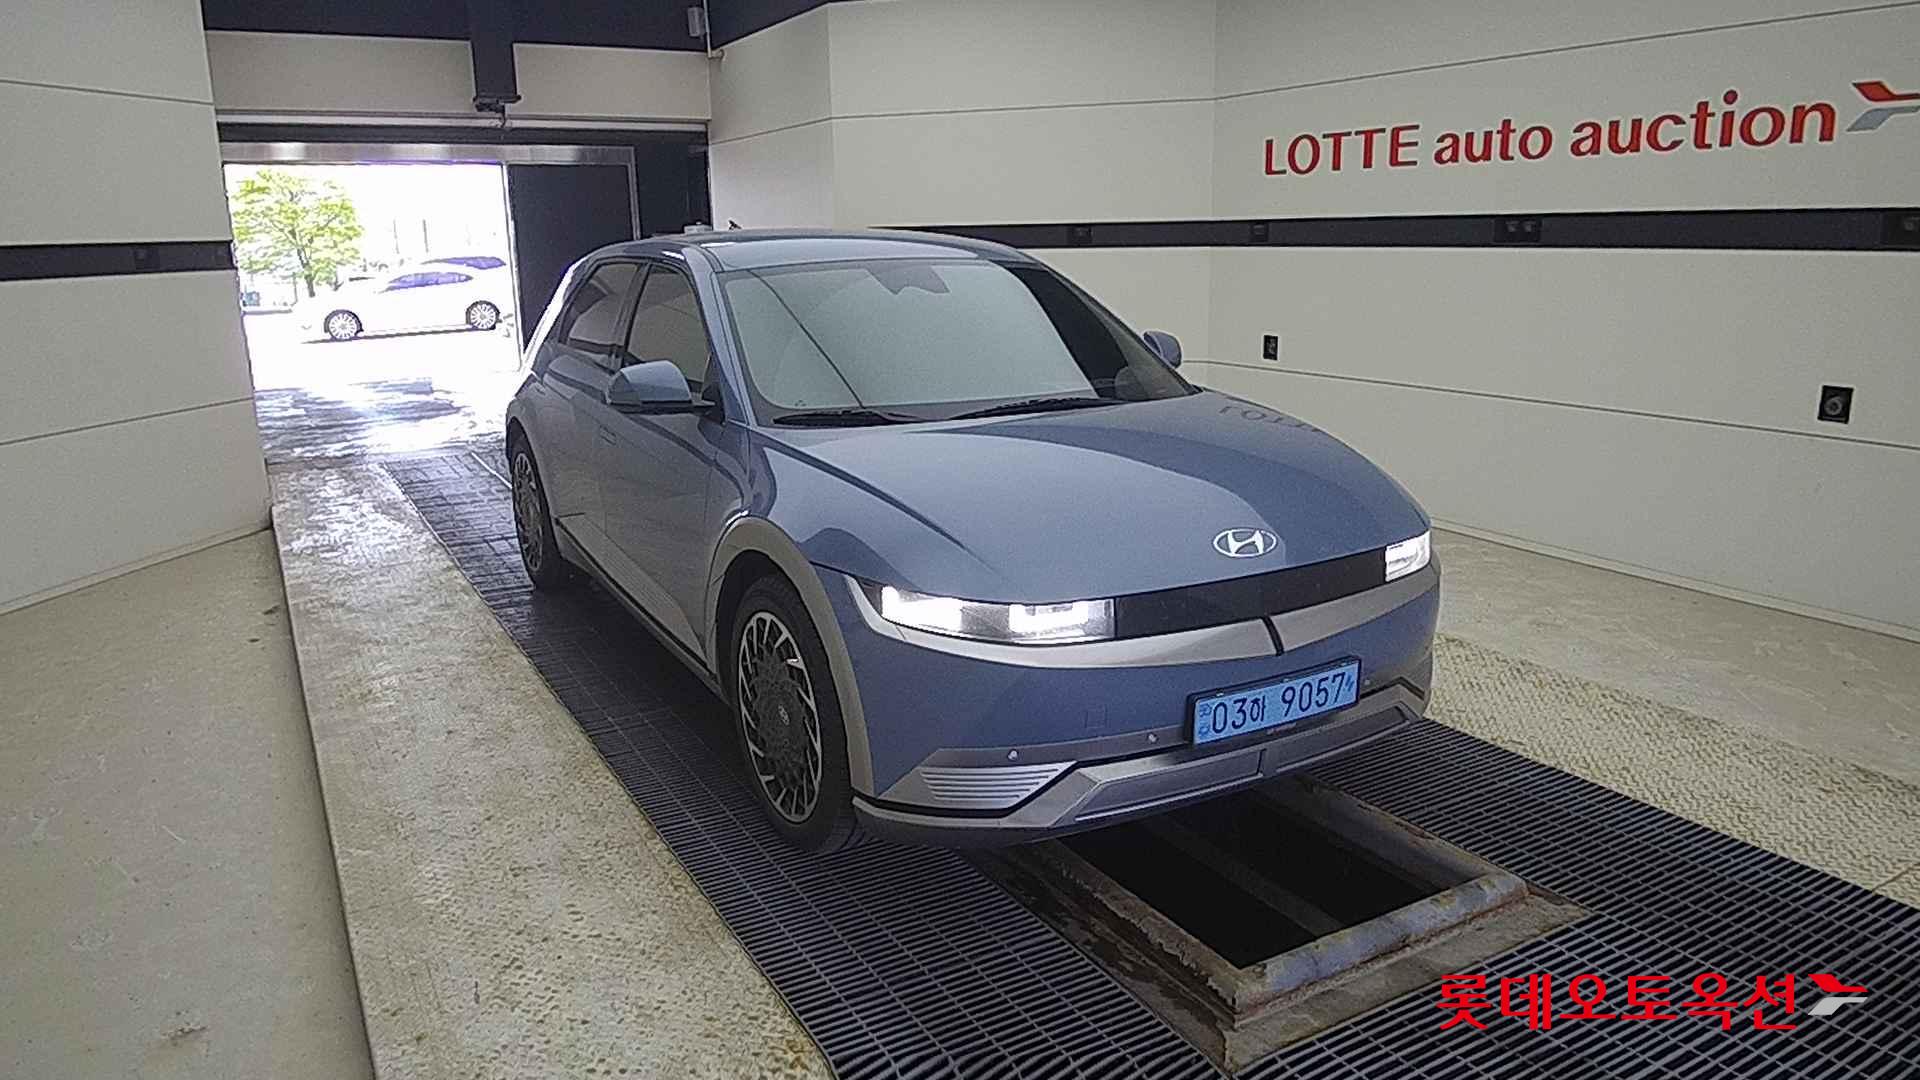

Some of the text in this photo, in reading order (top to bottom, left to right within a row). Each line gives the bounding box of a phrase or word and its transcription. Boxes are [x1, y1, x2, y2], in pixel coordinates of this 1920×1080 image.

[1264, 90, 1836, 175] LOTTE auto auction
[1212, 694, 1266, 734] 03하
[1280, 671, 1346, 718] 9057
